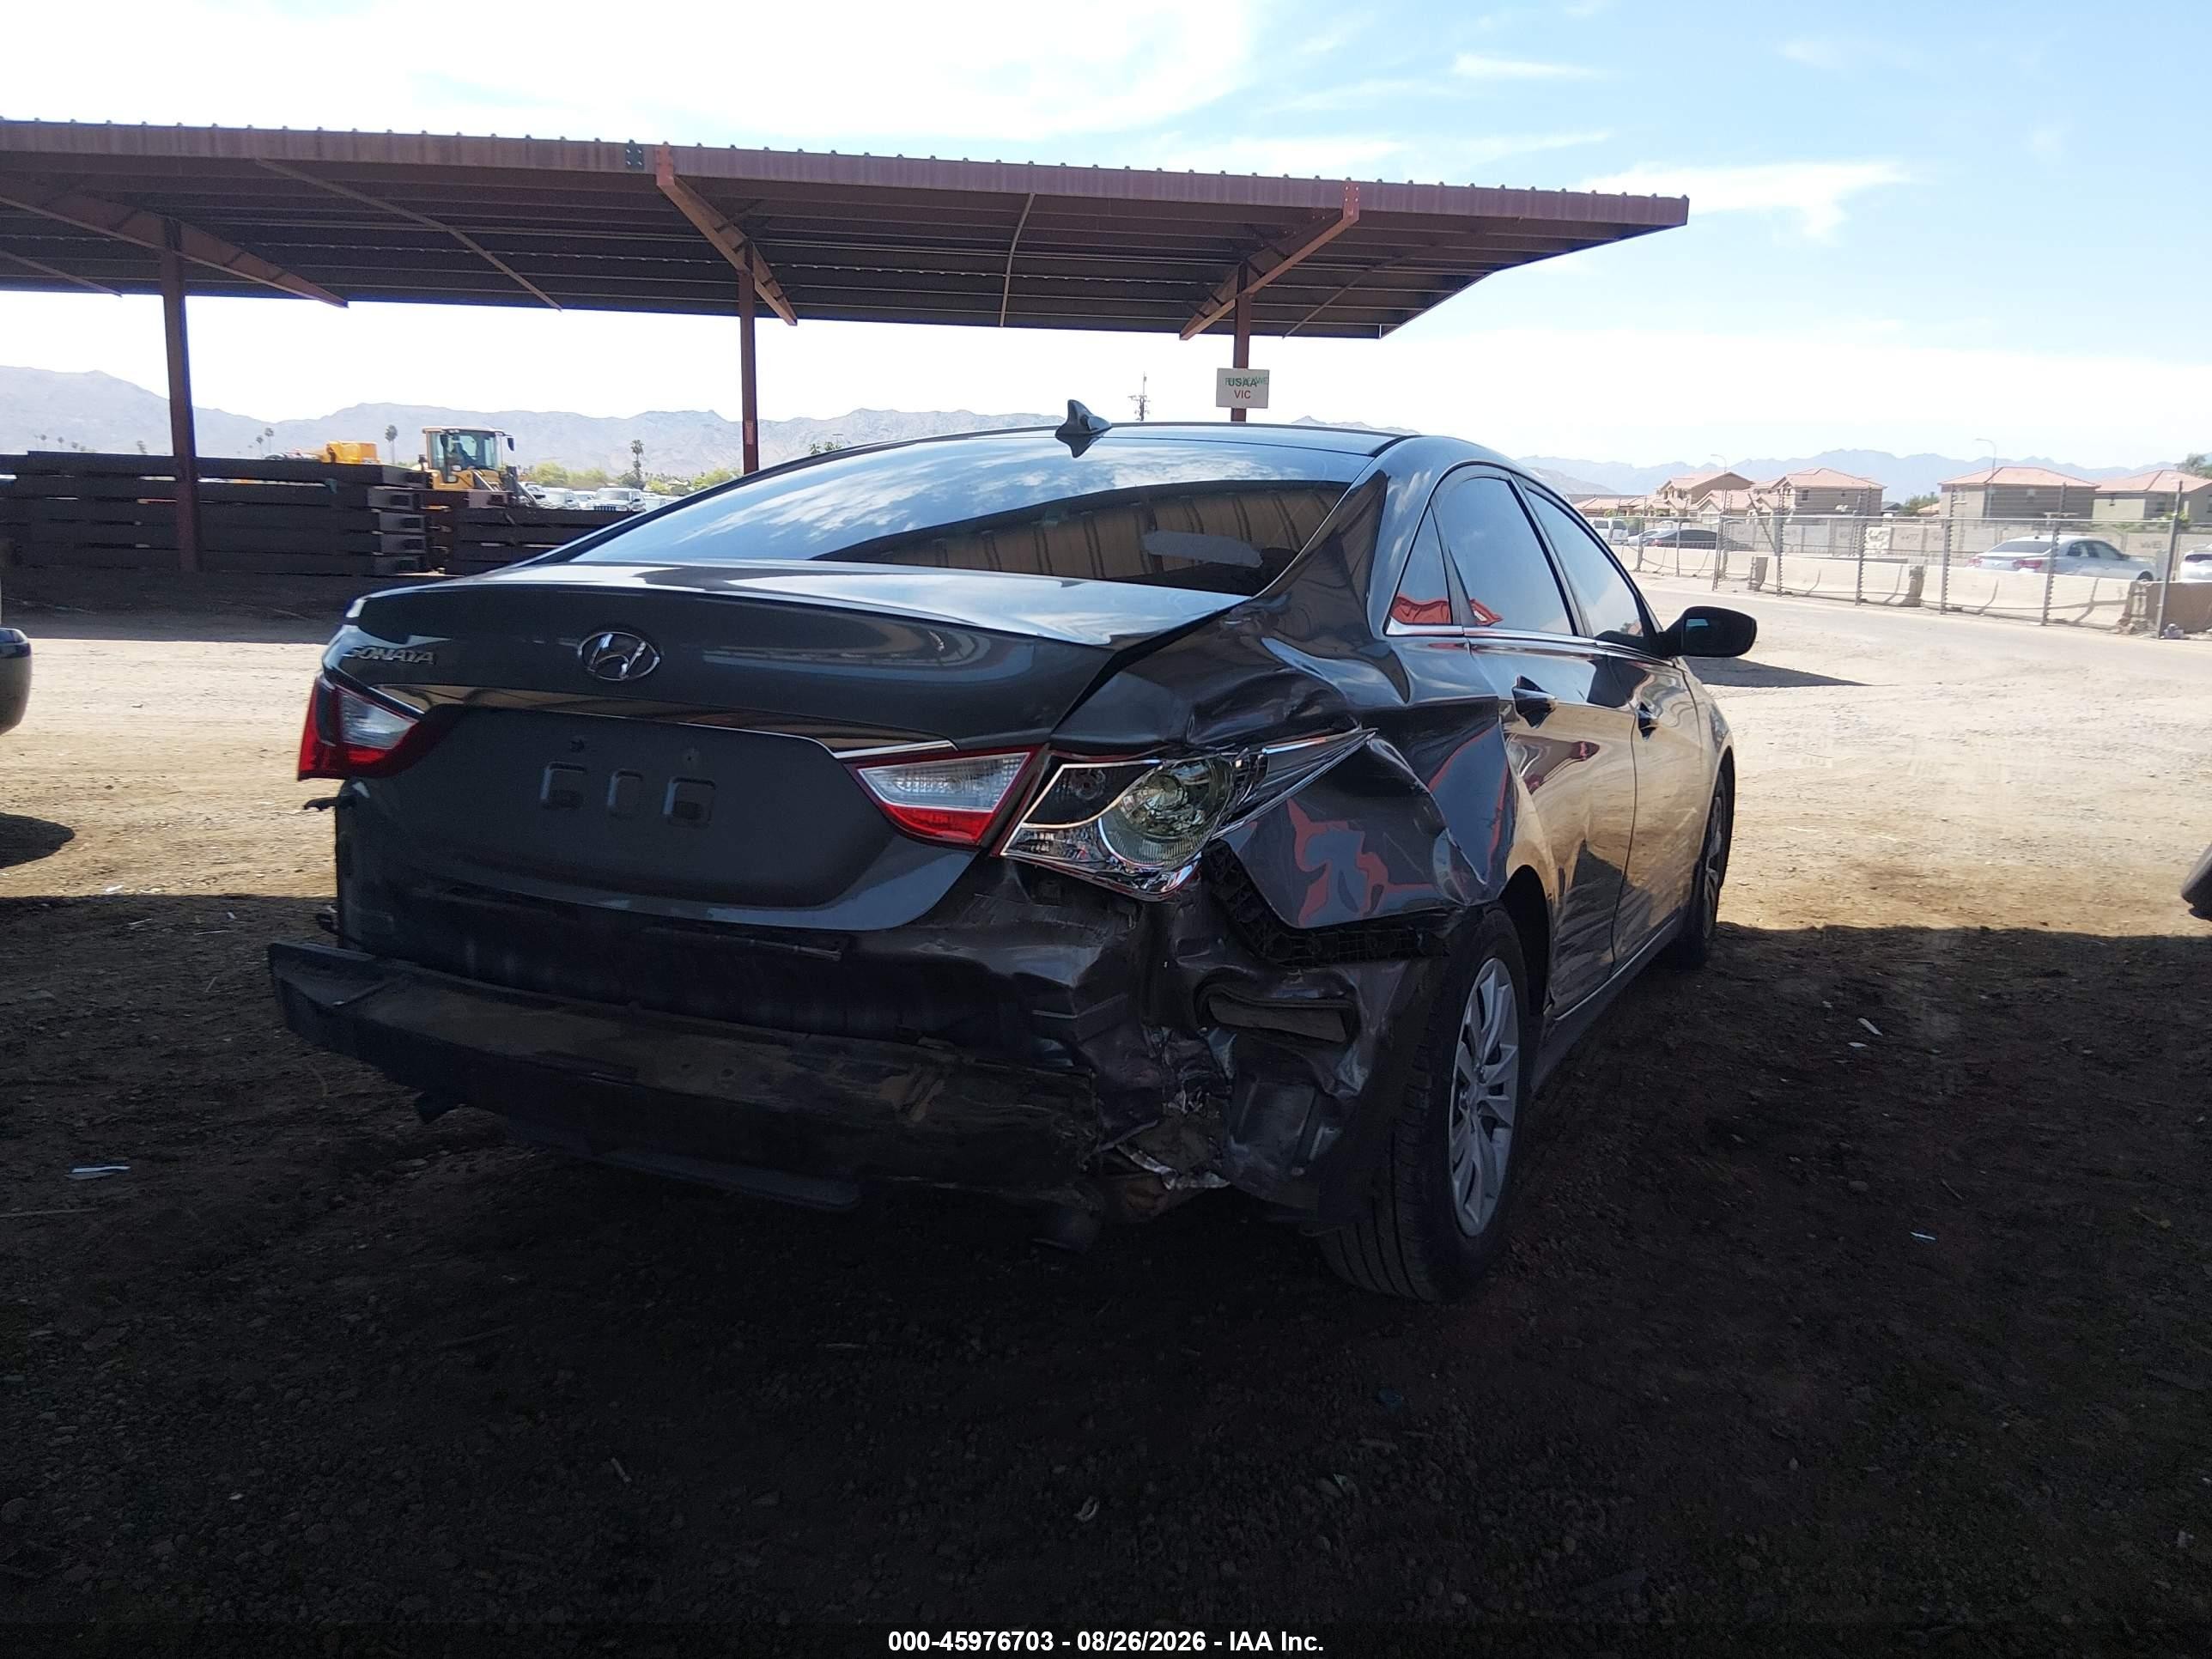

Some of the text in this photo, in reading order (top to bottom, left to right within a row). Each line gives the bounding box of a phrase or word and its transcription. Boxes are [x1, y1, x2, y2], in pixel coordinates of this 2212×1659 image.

[1228, 378, 1258, 387] USAA
[1234, 390, 1251, 399] VIC
[342, 645, 434, 665] SONATA
